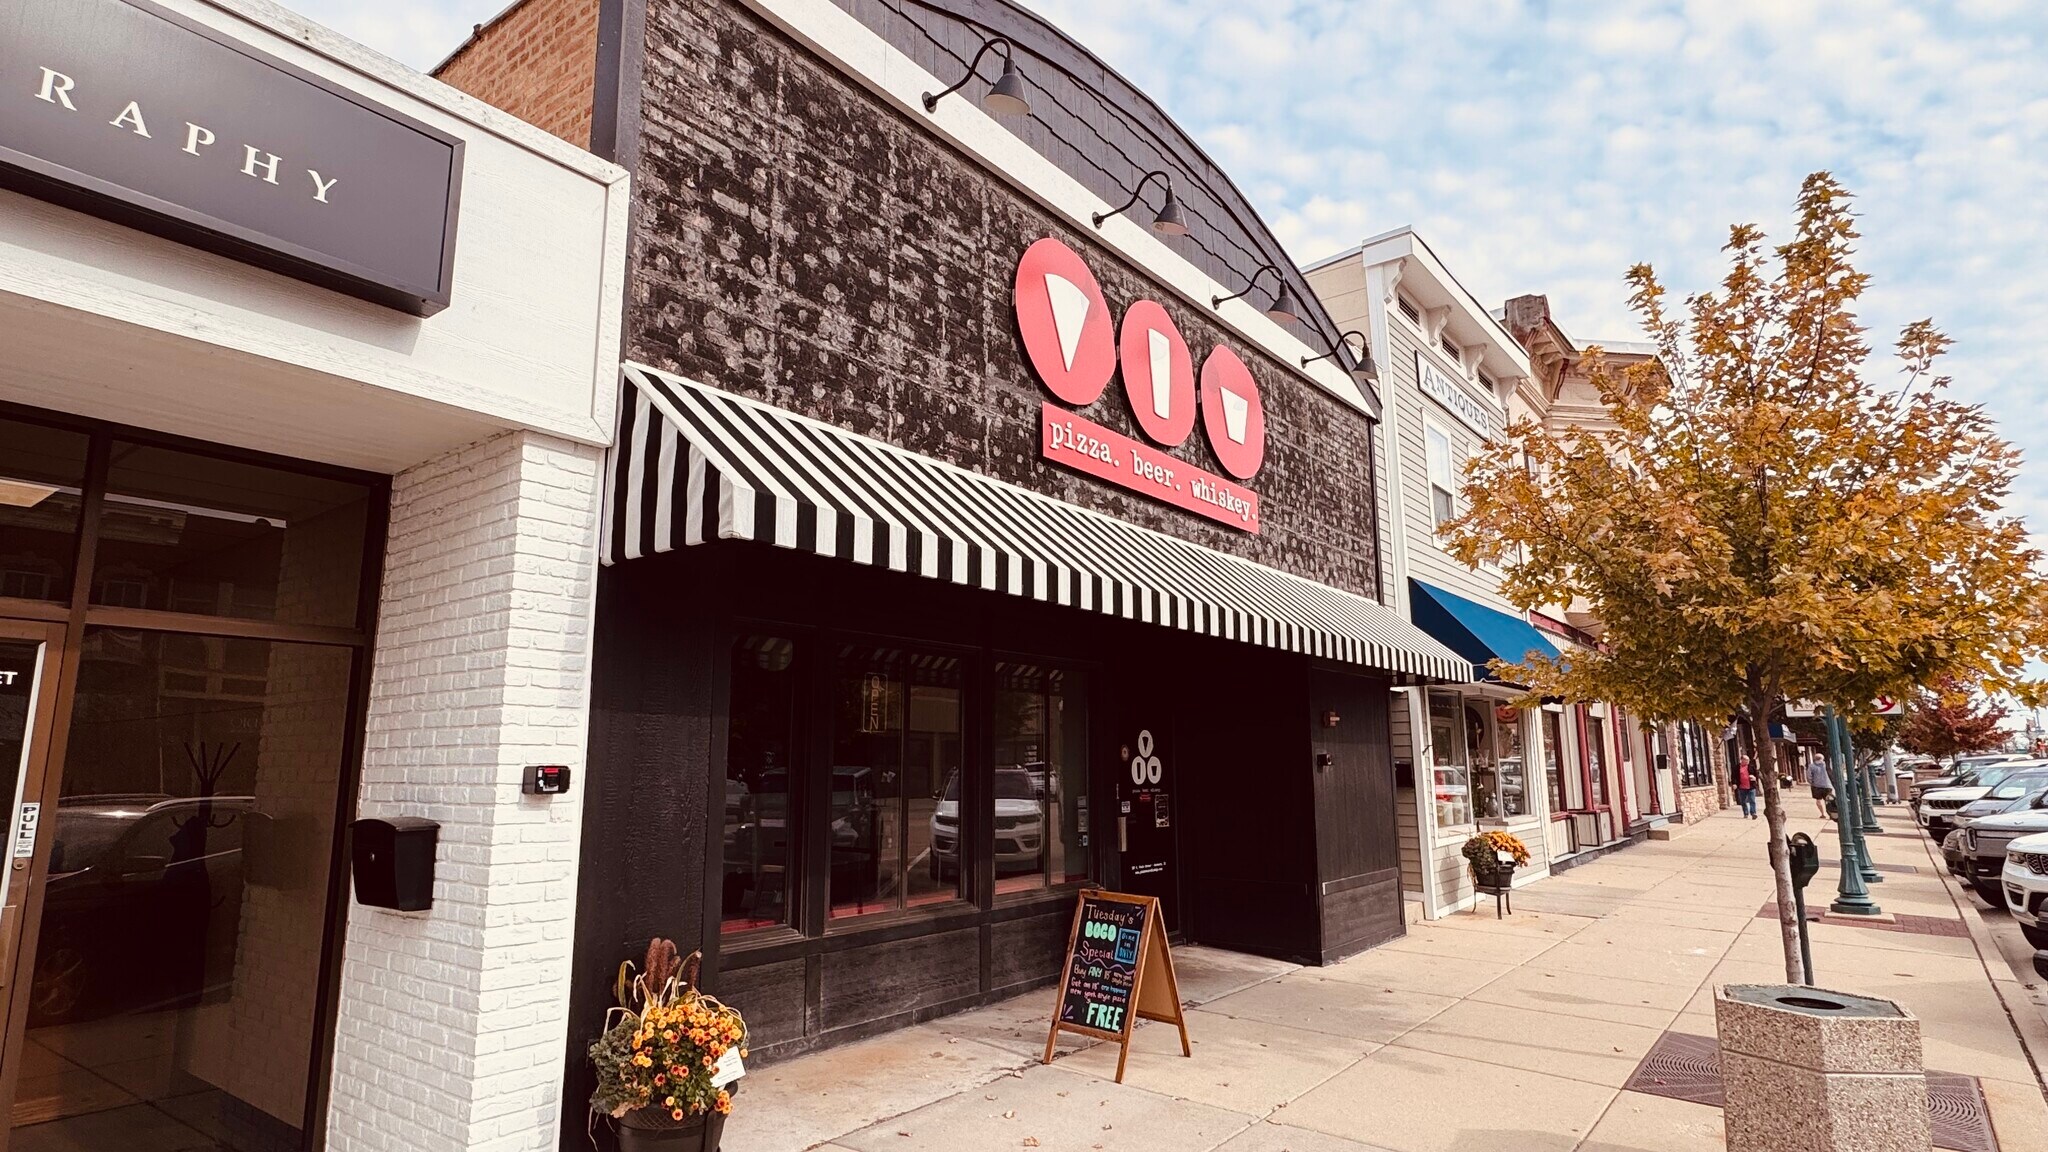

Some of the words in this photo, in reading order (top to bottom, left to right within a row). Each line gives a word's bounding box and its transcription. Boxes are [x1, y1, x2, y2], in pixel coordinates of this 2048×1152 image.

[34, 65, 338, 204] RAPHY
[1423, 365, 1488, 430] ANTIQUES
[1049, 421, 1120, 468] pizza.
[1131, 449, 1181, 491] beer.
[1190, 477, 1257, 521] whiskey.
[869, 675, 881, 733] OPEN
[19, 806, 37, 839] PULL
[1085, 903, 1134, 927] Tuesday's
[1085, 920, 1117, 942] BOGO
[1080, 940, 1114, 961] Special
[1071, 976, 1082, 988] Get
[1073, 963, 1087, 979] Buy
[1088, 966, 1103, 978] ANY
[1085, 1002, 1124, 1031] FREE
